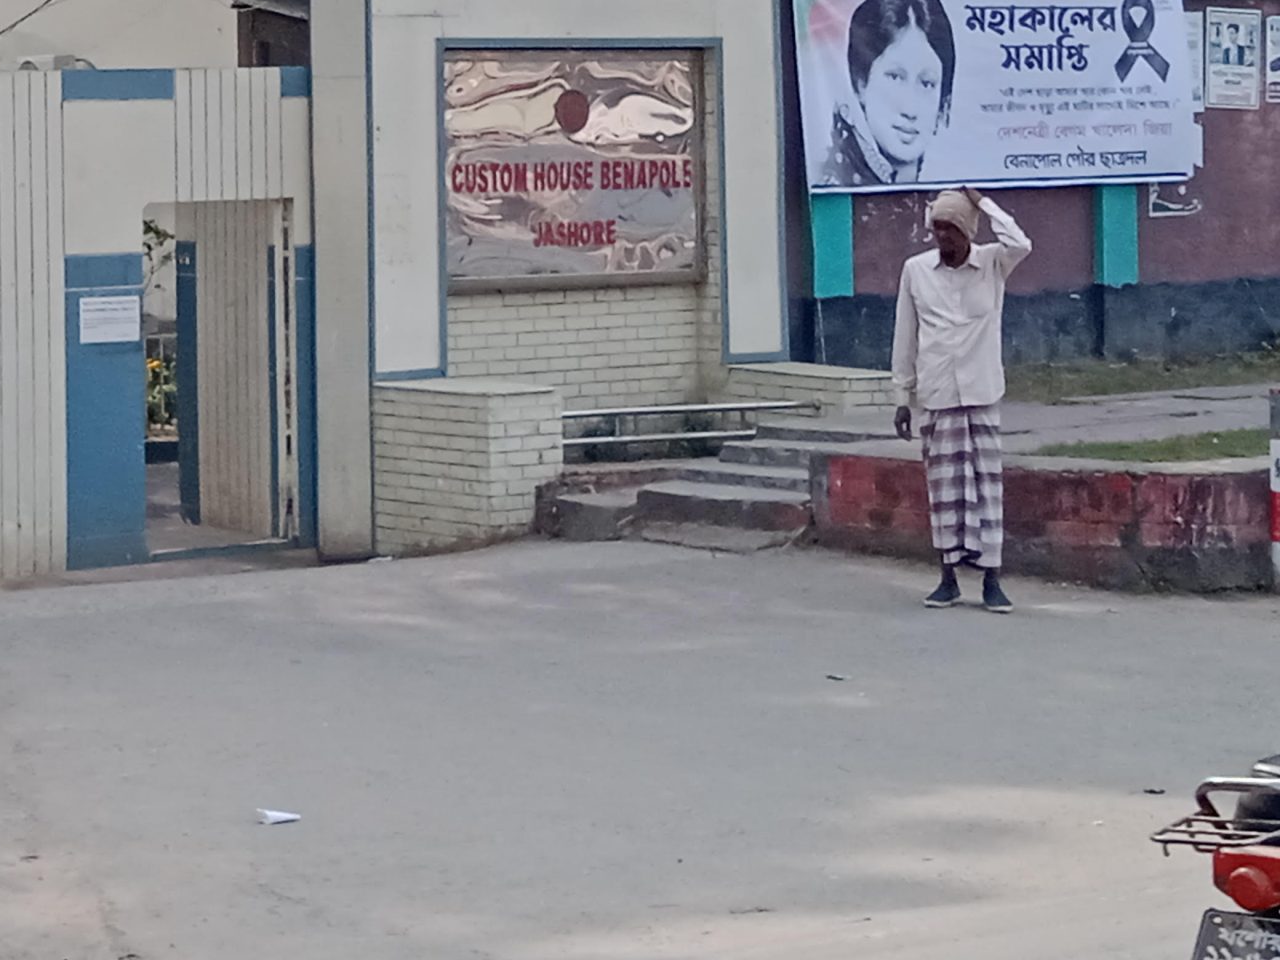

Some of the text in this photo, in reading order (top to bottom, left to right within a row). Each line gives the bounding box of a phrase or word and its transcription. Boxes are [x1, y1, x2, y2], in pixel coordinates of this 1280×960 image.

[964, 4, 1117, 35] মহাকালের
[1000, 35, 1090, 72] সমাপ্তি
[1004, 153, 1062, 169] বেনাপোল
[1067, 145, 1095, 167] পৌর
[534, 161, 594, 192] HOUSE
[600, 159, 693, 190] BENAPOLE
[532, 220, 617, 248] JASHORE
